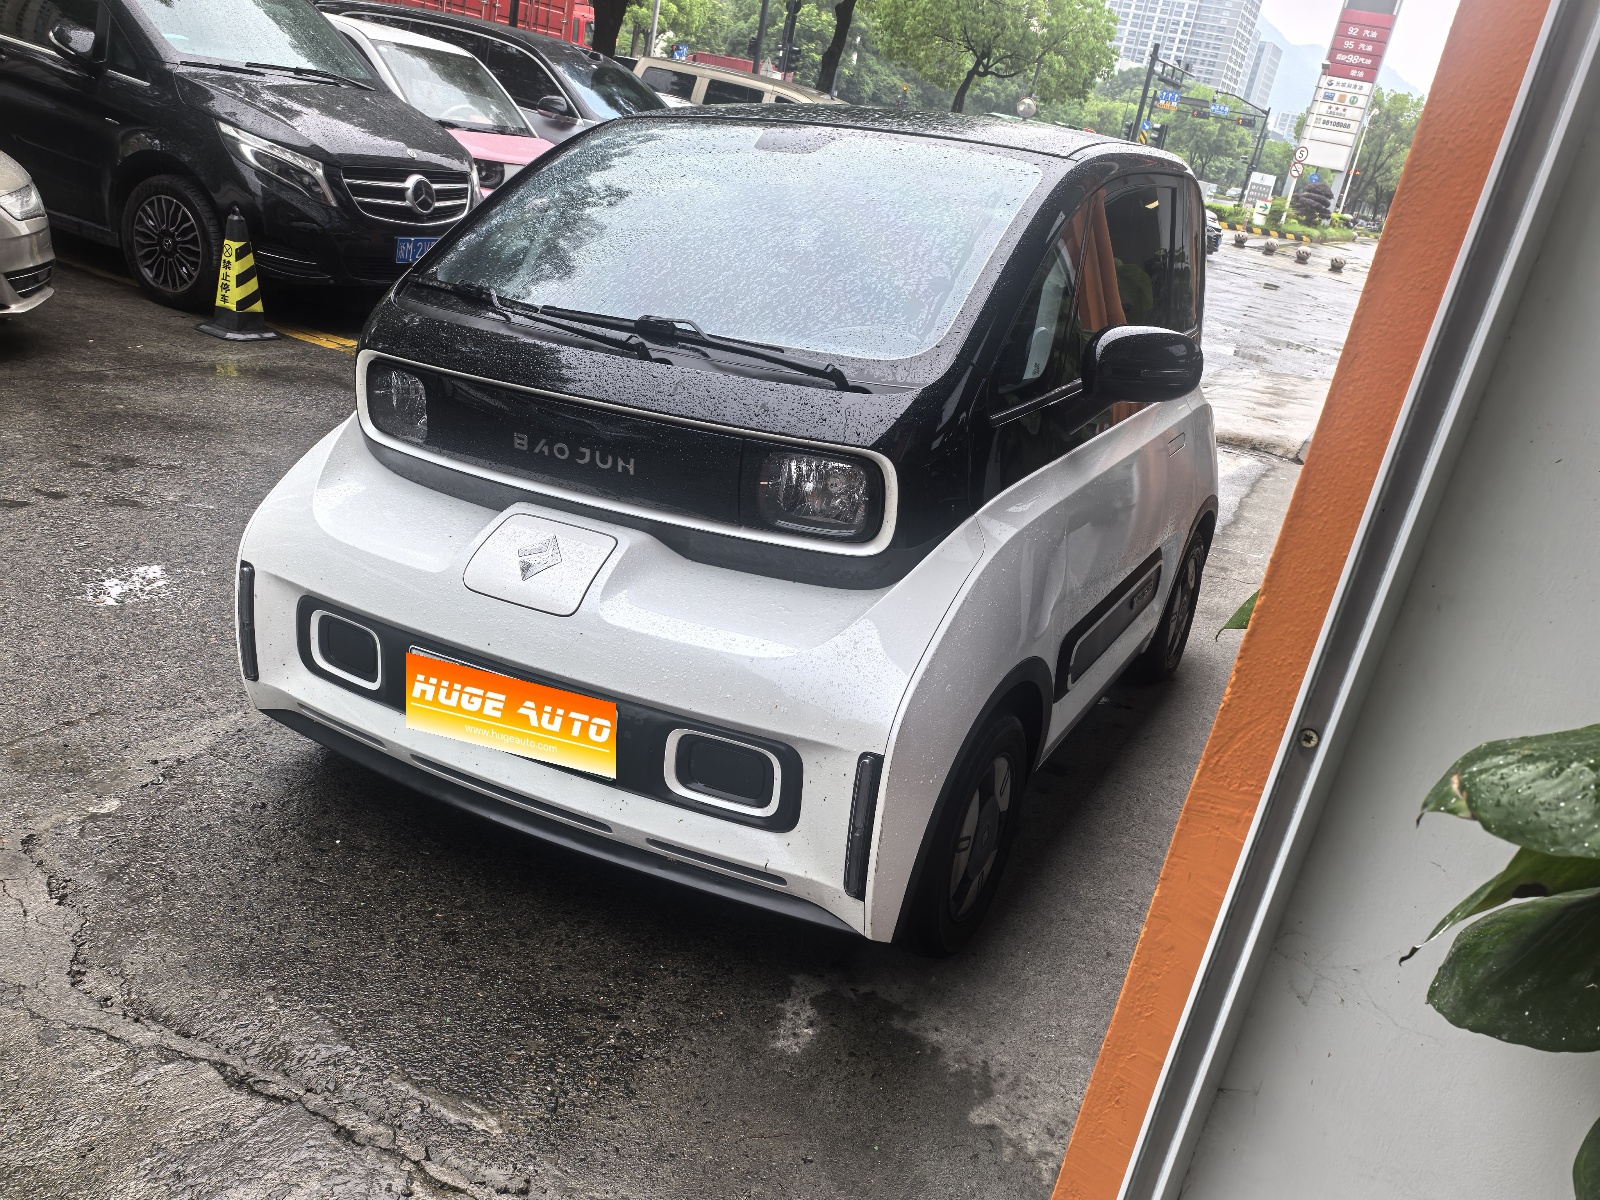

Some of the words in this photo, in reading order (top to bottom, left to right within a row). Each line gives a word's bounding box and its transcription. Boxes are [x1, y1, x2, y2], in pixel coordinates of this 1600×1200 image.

[1347, 26, 1359, 36] 92
[1362, 29, 1378, 38] 汽油
[1343, 40, 1355, 49] 95
[1357, 43, 1373, 52] 汽油
[1298, 149, 1305, 159] 5
[220, 259, 232, 304] 禁止停车
[513, 432, 635, 476] BAOJUN
